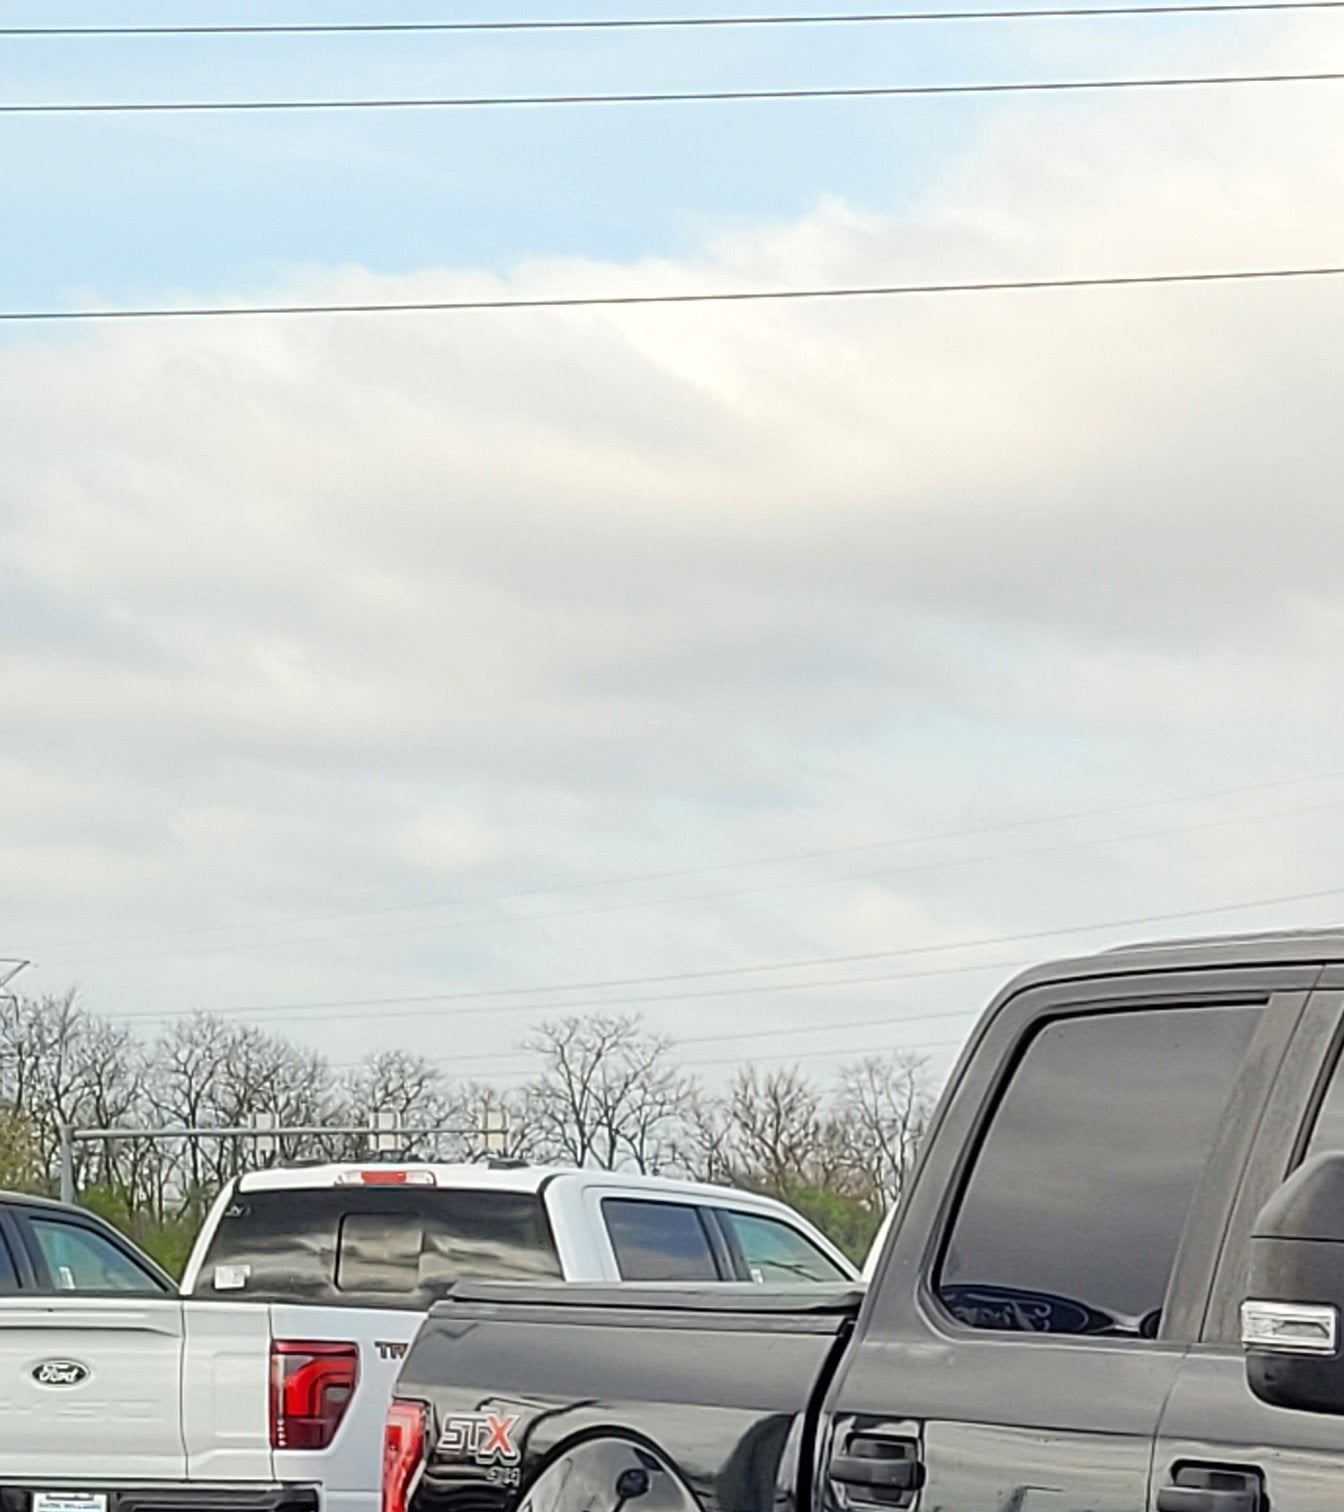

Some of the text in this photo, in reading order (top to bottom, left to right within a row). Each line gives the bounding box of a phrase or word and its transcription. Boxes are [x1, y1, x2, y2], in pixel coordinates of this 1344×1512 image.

[375, 1341, 409, 1359] TR
[40, 1363, 79, 1383] Ford
[437, 1412, 521, 1466] STX
